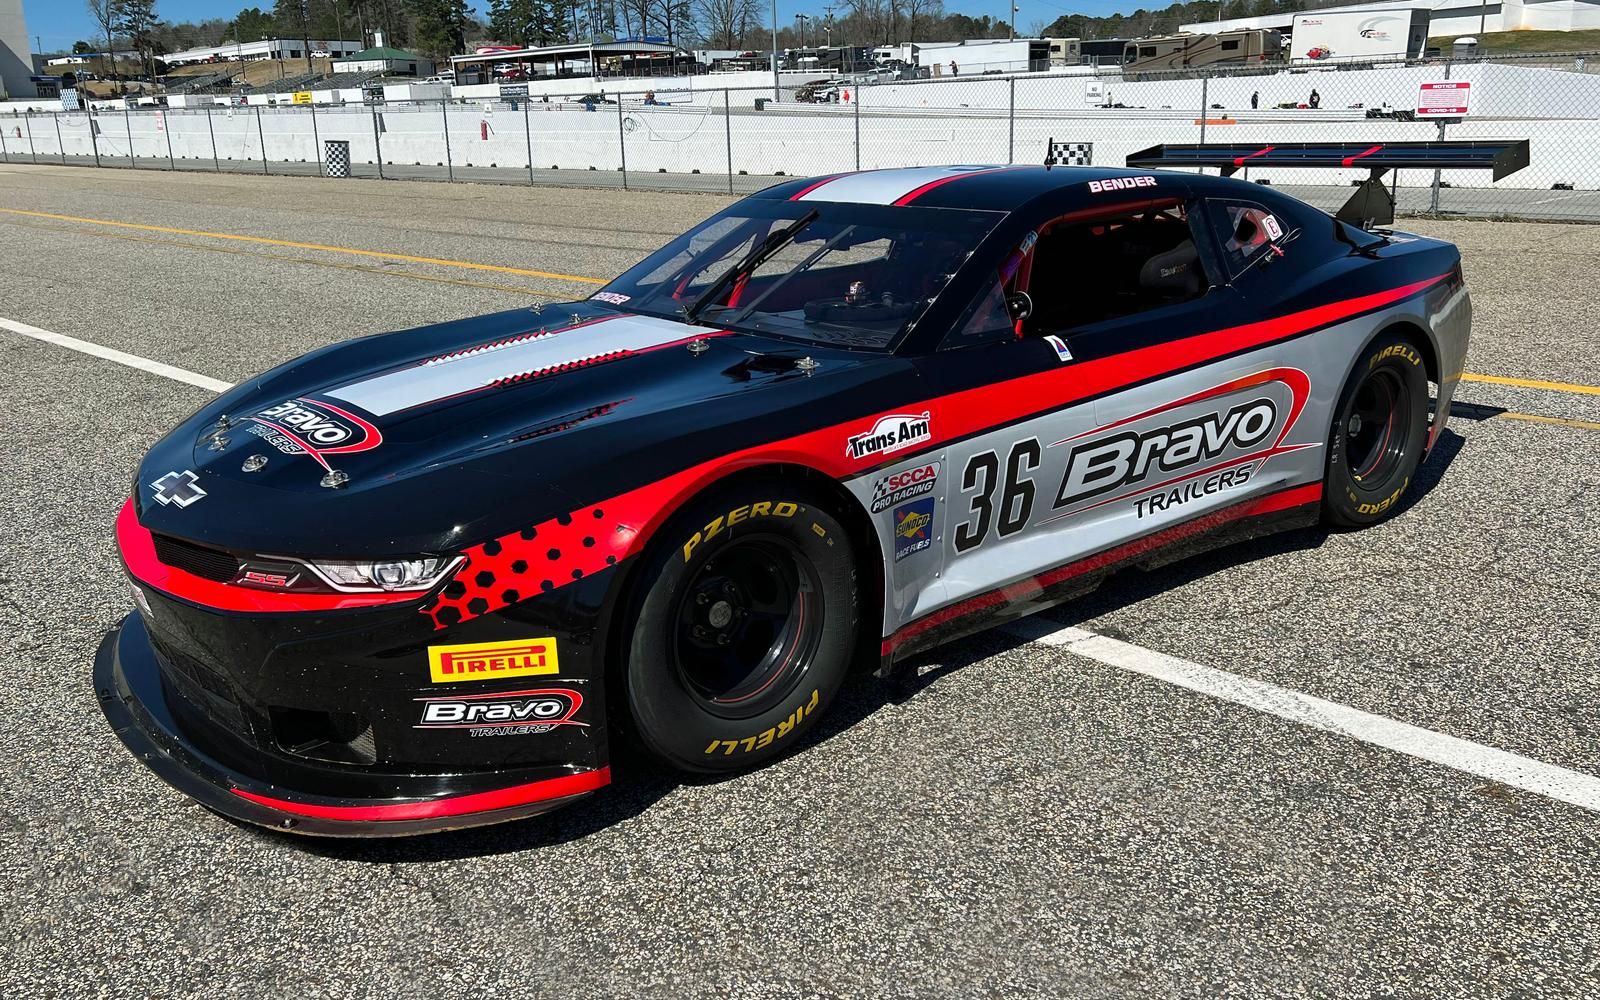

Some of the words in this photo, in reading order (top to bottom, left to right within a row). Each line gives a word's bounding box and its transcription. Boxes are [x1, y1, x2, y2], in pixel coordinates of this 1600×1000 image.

[1088, 176, 1158, 193] BENDER
[1369, 344, 1420, 369] PIRELLI
[257, 400, 351, 445] Bravo
[849, 431, 896, 458] Trans
[898, 420, 928, 443] Am
[1055, 400, 1276, 506] Bravo
[888, 465, 936, 491] SCCA
[1132, 464, 1254, 519] TRAILERS
[872, 495, 891, 512] PRO
[892, 481, 933, 503] RACING
[955, 437, 1041, 554] 36
[896, 514, 930, 537] SUNOCO
[896, 545, 910, 561] RACE
[910, 538, 931, 552] FUELS
[243, 571, 286, 586] SS
[440, 645, 547, 675] PIRELLI
[421, 699, 564, 724] Bravo
[704, 688, 820, 756] PIRELLI
[469, 724, 551, 737] TRAILERS
